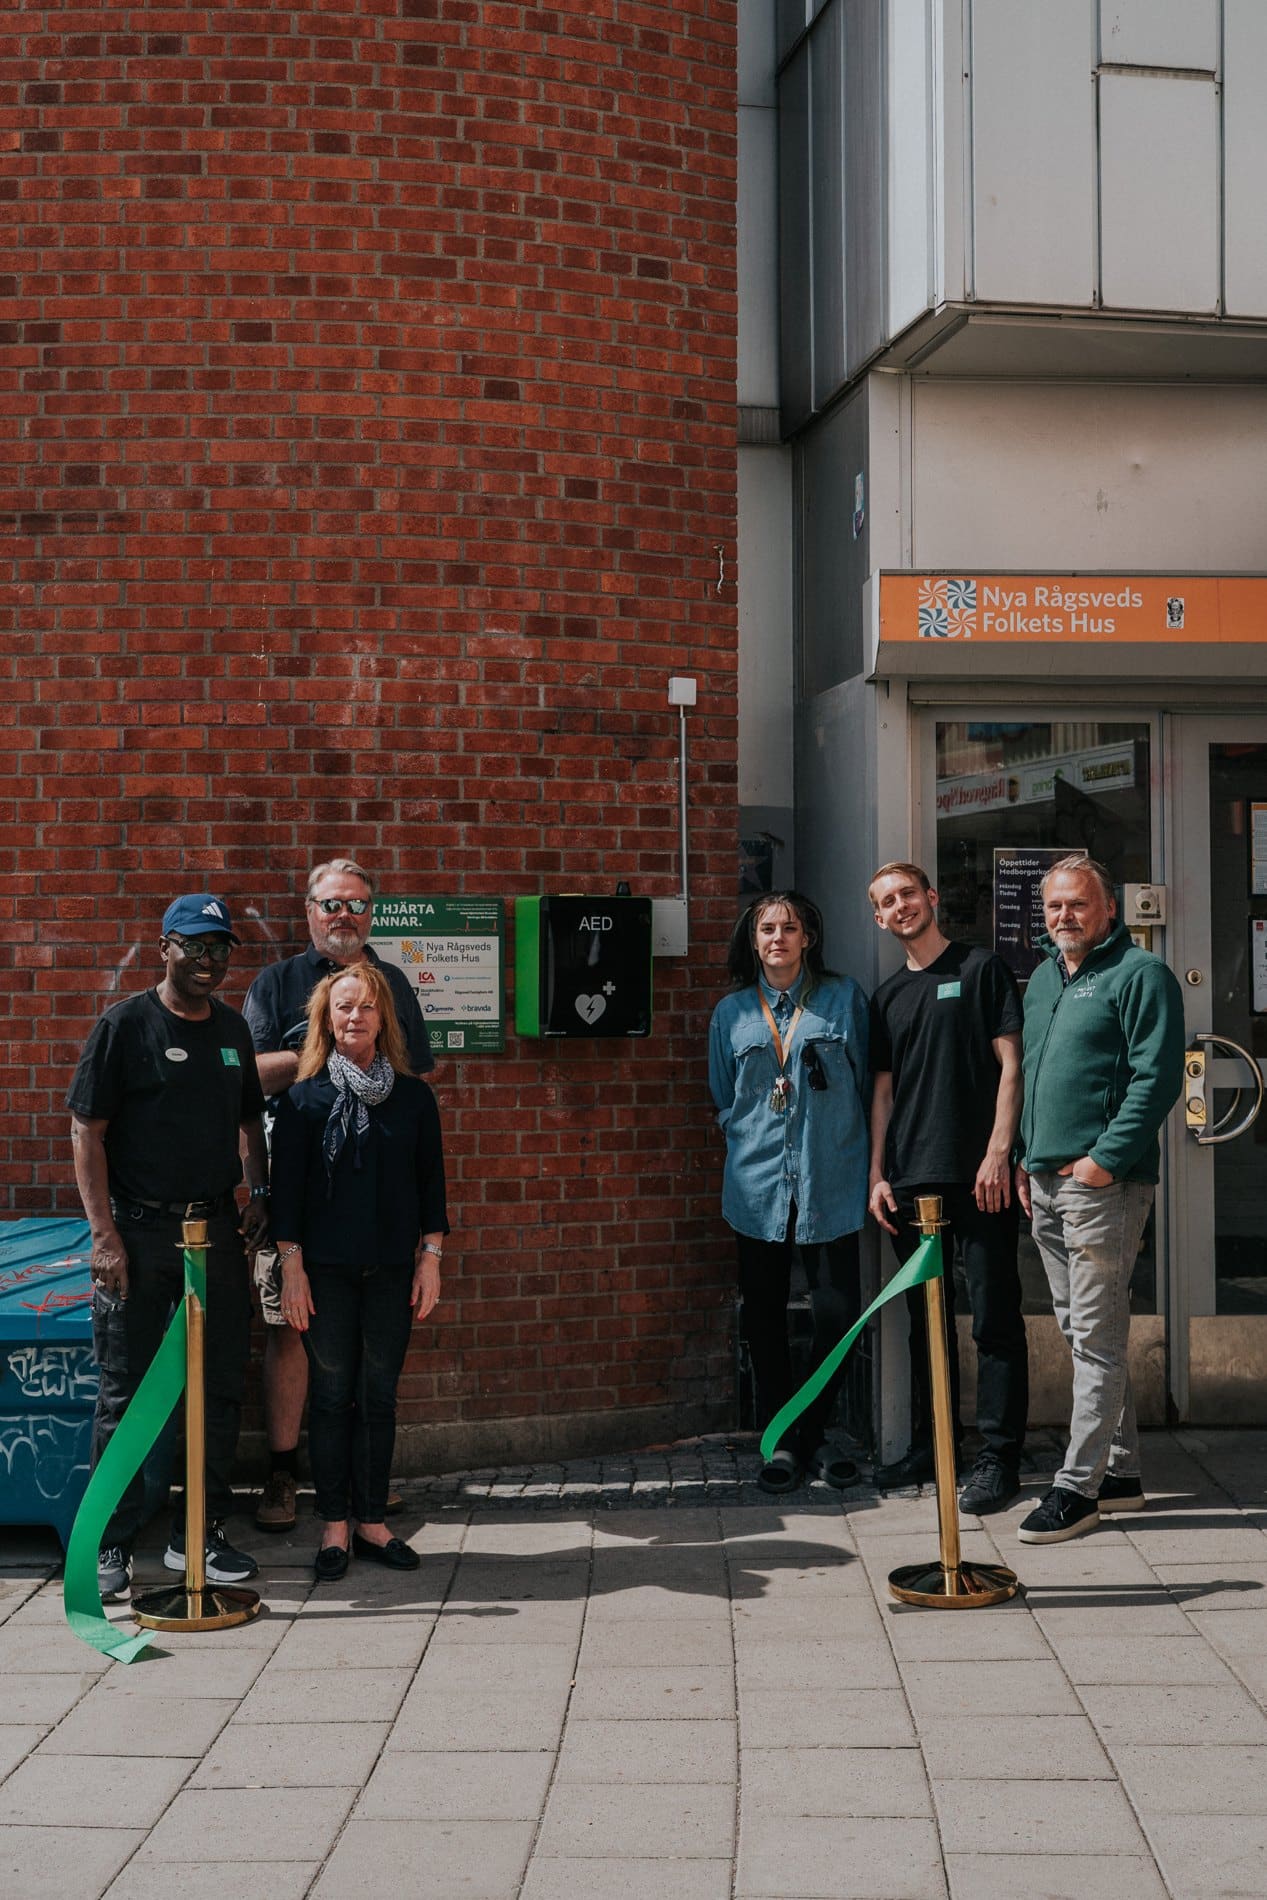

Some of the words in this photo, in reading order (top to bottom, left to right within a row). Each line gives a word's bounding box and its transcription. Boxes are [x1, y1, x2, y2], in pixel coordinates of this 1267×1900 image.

[983, 586, 1027, 611] Nya
[1035, 585, 1143, 612] Rågsveds
[983, 612, 1064, 633] Folkets
[1071, 612, 1116, 634] Hus
[1000, 857, 1039, 867] Öppettider
[382, 901, 435, 914] HJÄRTA
[578, 916, 613, 931] AED
[426, 942, 444, 953] Nya
[447, 942, 491, 953] Rågsveds
[426, 954, 458, 962] Folkets
[461, 954, 480, 962] Hus
[418, 971, 435, 980] ICA
